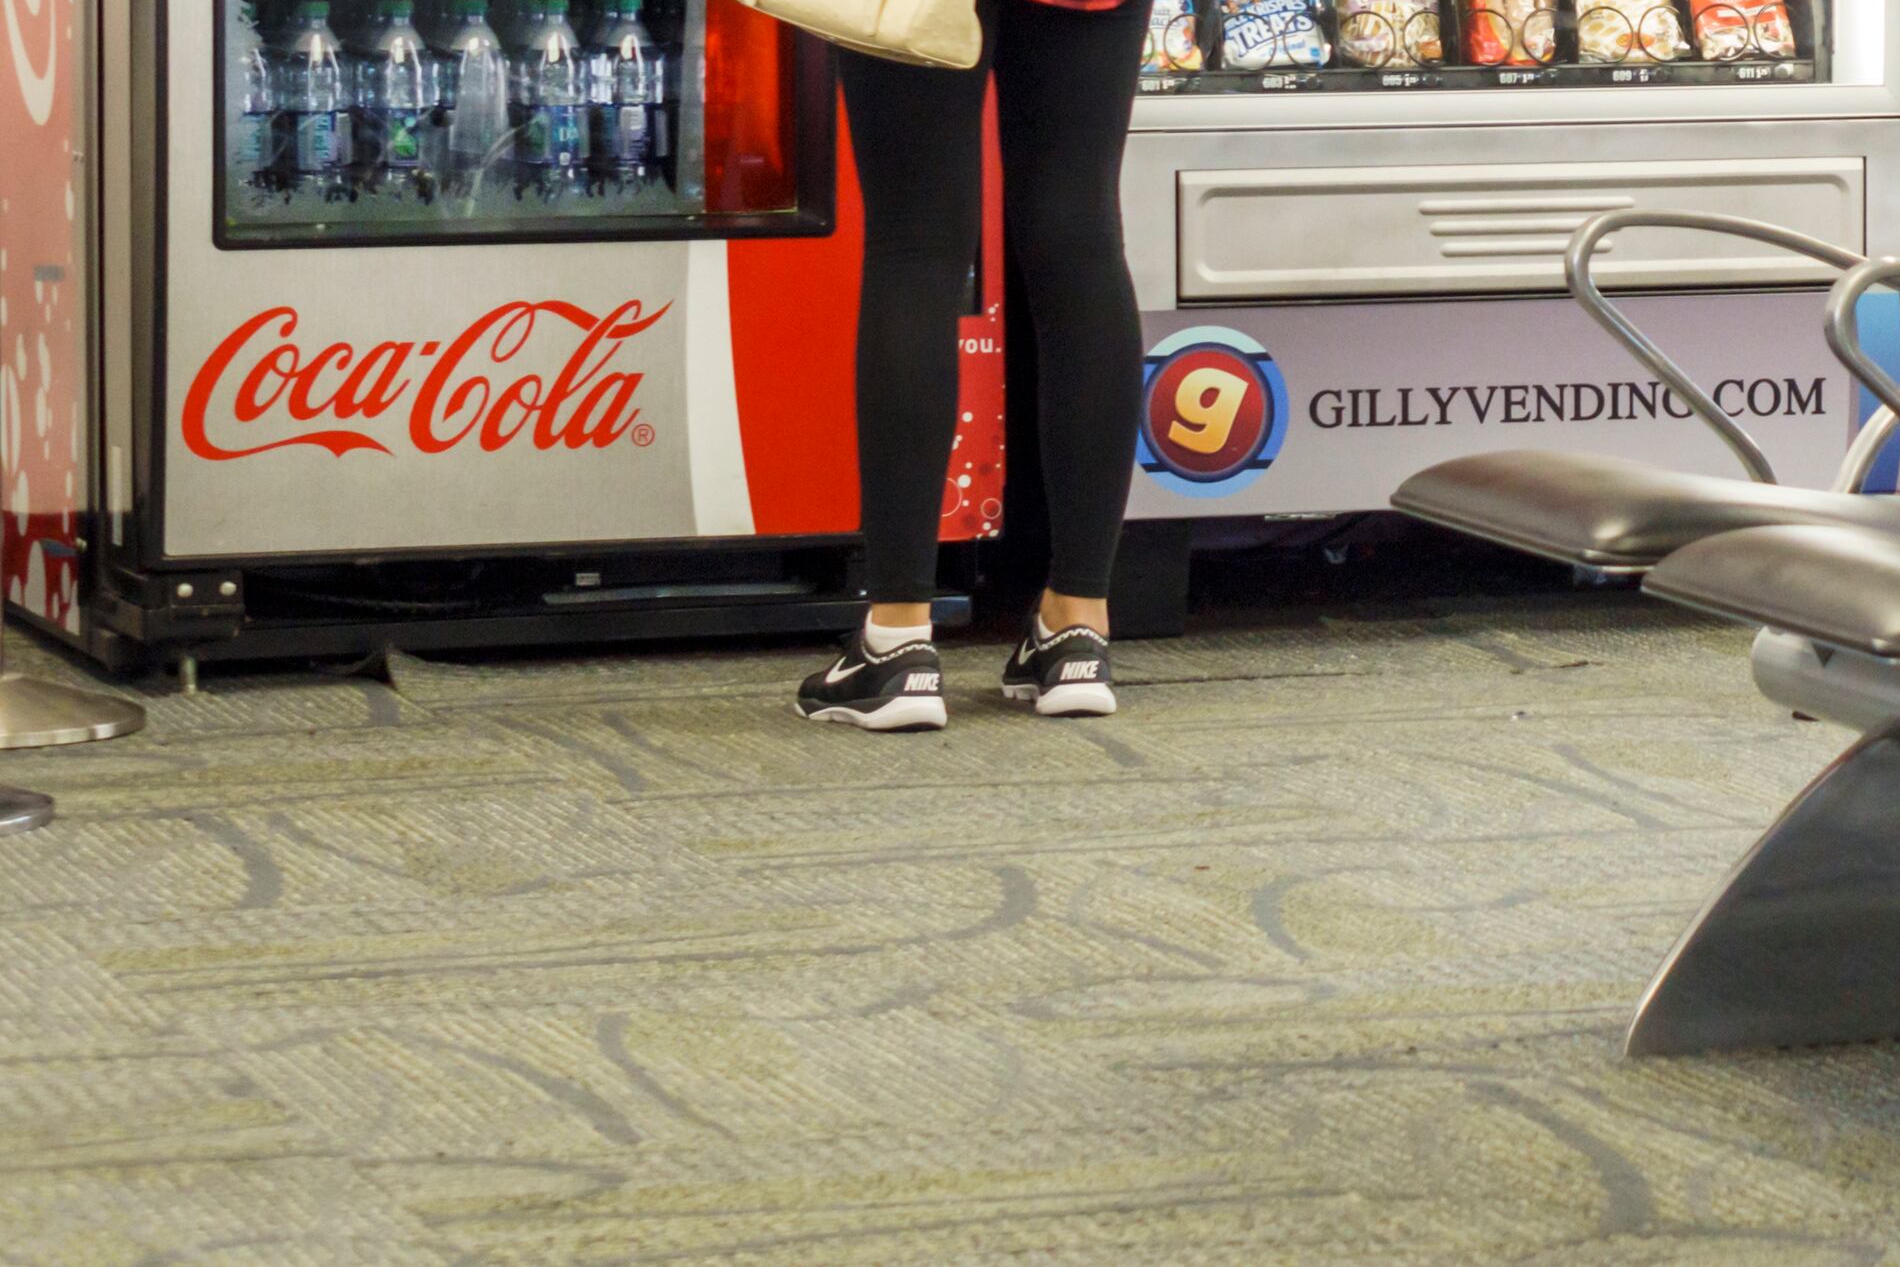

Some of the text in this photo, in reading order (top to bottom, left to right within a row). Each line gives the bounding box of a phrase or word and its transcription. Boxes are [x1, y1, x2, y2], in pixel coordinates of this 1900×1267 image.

[1228, 13, 1315, 57] TREATS
[181, 299, 675, 461] Coca-Cola
[1308, 376, 1828, 431] GILLYVENDINGCOM
[903, 672, 940, 692] NIKE
[1060, 660, 1099, 680] NIKE
